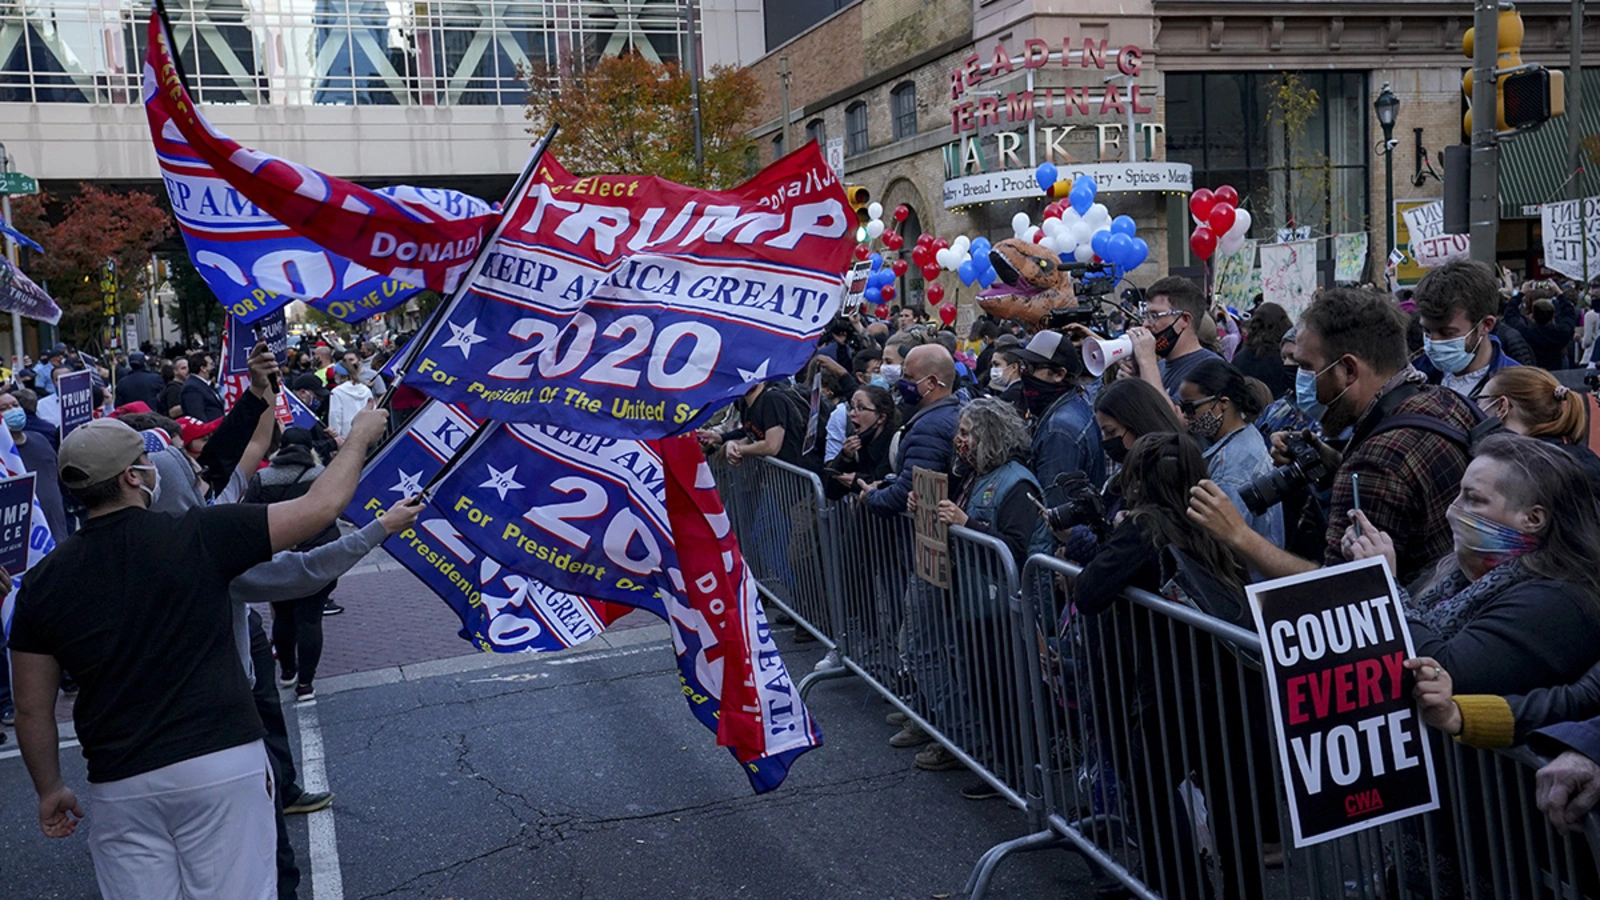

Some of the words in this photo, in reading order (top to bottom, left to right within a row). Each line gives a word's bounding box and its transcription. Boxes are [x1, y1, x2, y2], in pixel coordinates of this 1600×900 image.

[951, 37, 1143, 100] READING
[950, 84, 1152, 135] TERMINAL
[942, 123, 1165, 178] MARKET
[21, 182, 33, 191] St
[963, 180, 992, 197] Bread
[1001, 173, 1041, 192] Produ
[1072, 170, 1113, 187] Diry
[1125, 168, 1161, 186] Spices
[520, 183, 848, 256] TRUMP
[370, 232, 477, 262] DONALD
[688, 275, 829, 324] GREAT!
[457, 329, 471, 344] '16
[487, 311, 722, 391] 2020
[62, 388, 90, 408] TRUMP
[65, 404, 89, 418] PENCE
[417, 357, 458, 387] For
[467, 381, 534, 405] President
[539, 386, 560, 404] Of
[563, 387, 602, 413] The
[611, 398, 665, 421] United
[454, 495, 494, 528] For
[502, 522, 606, 581] President
[1270, 596, 1396, 667] COUNT
[1286, 651, 1405, 725] EVERY
[1290, 708, 1419, 795] VOTE
[1344, 788, 1383, 816] CWA
